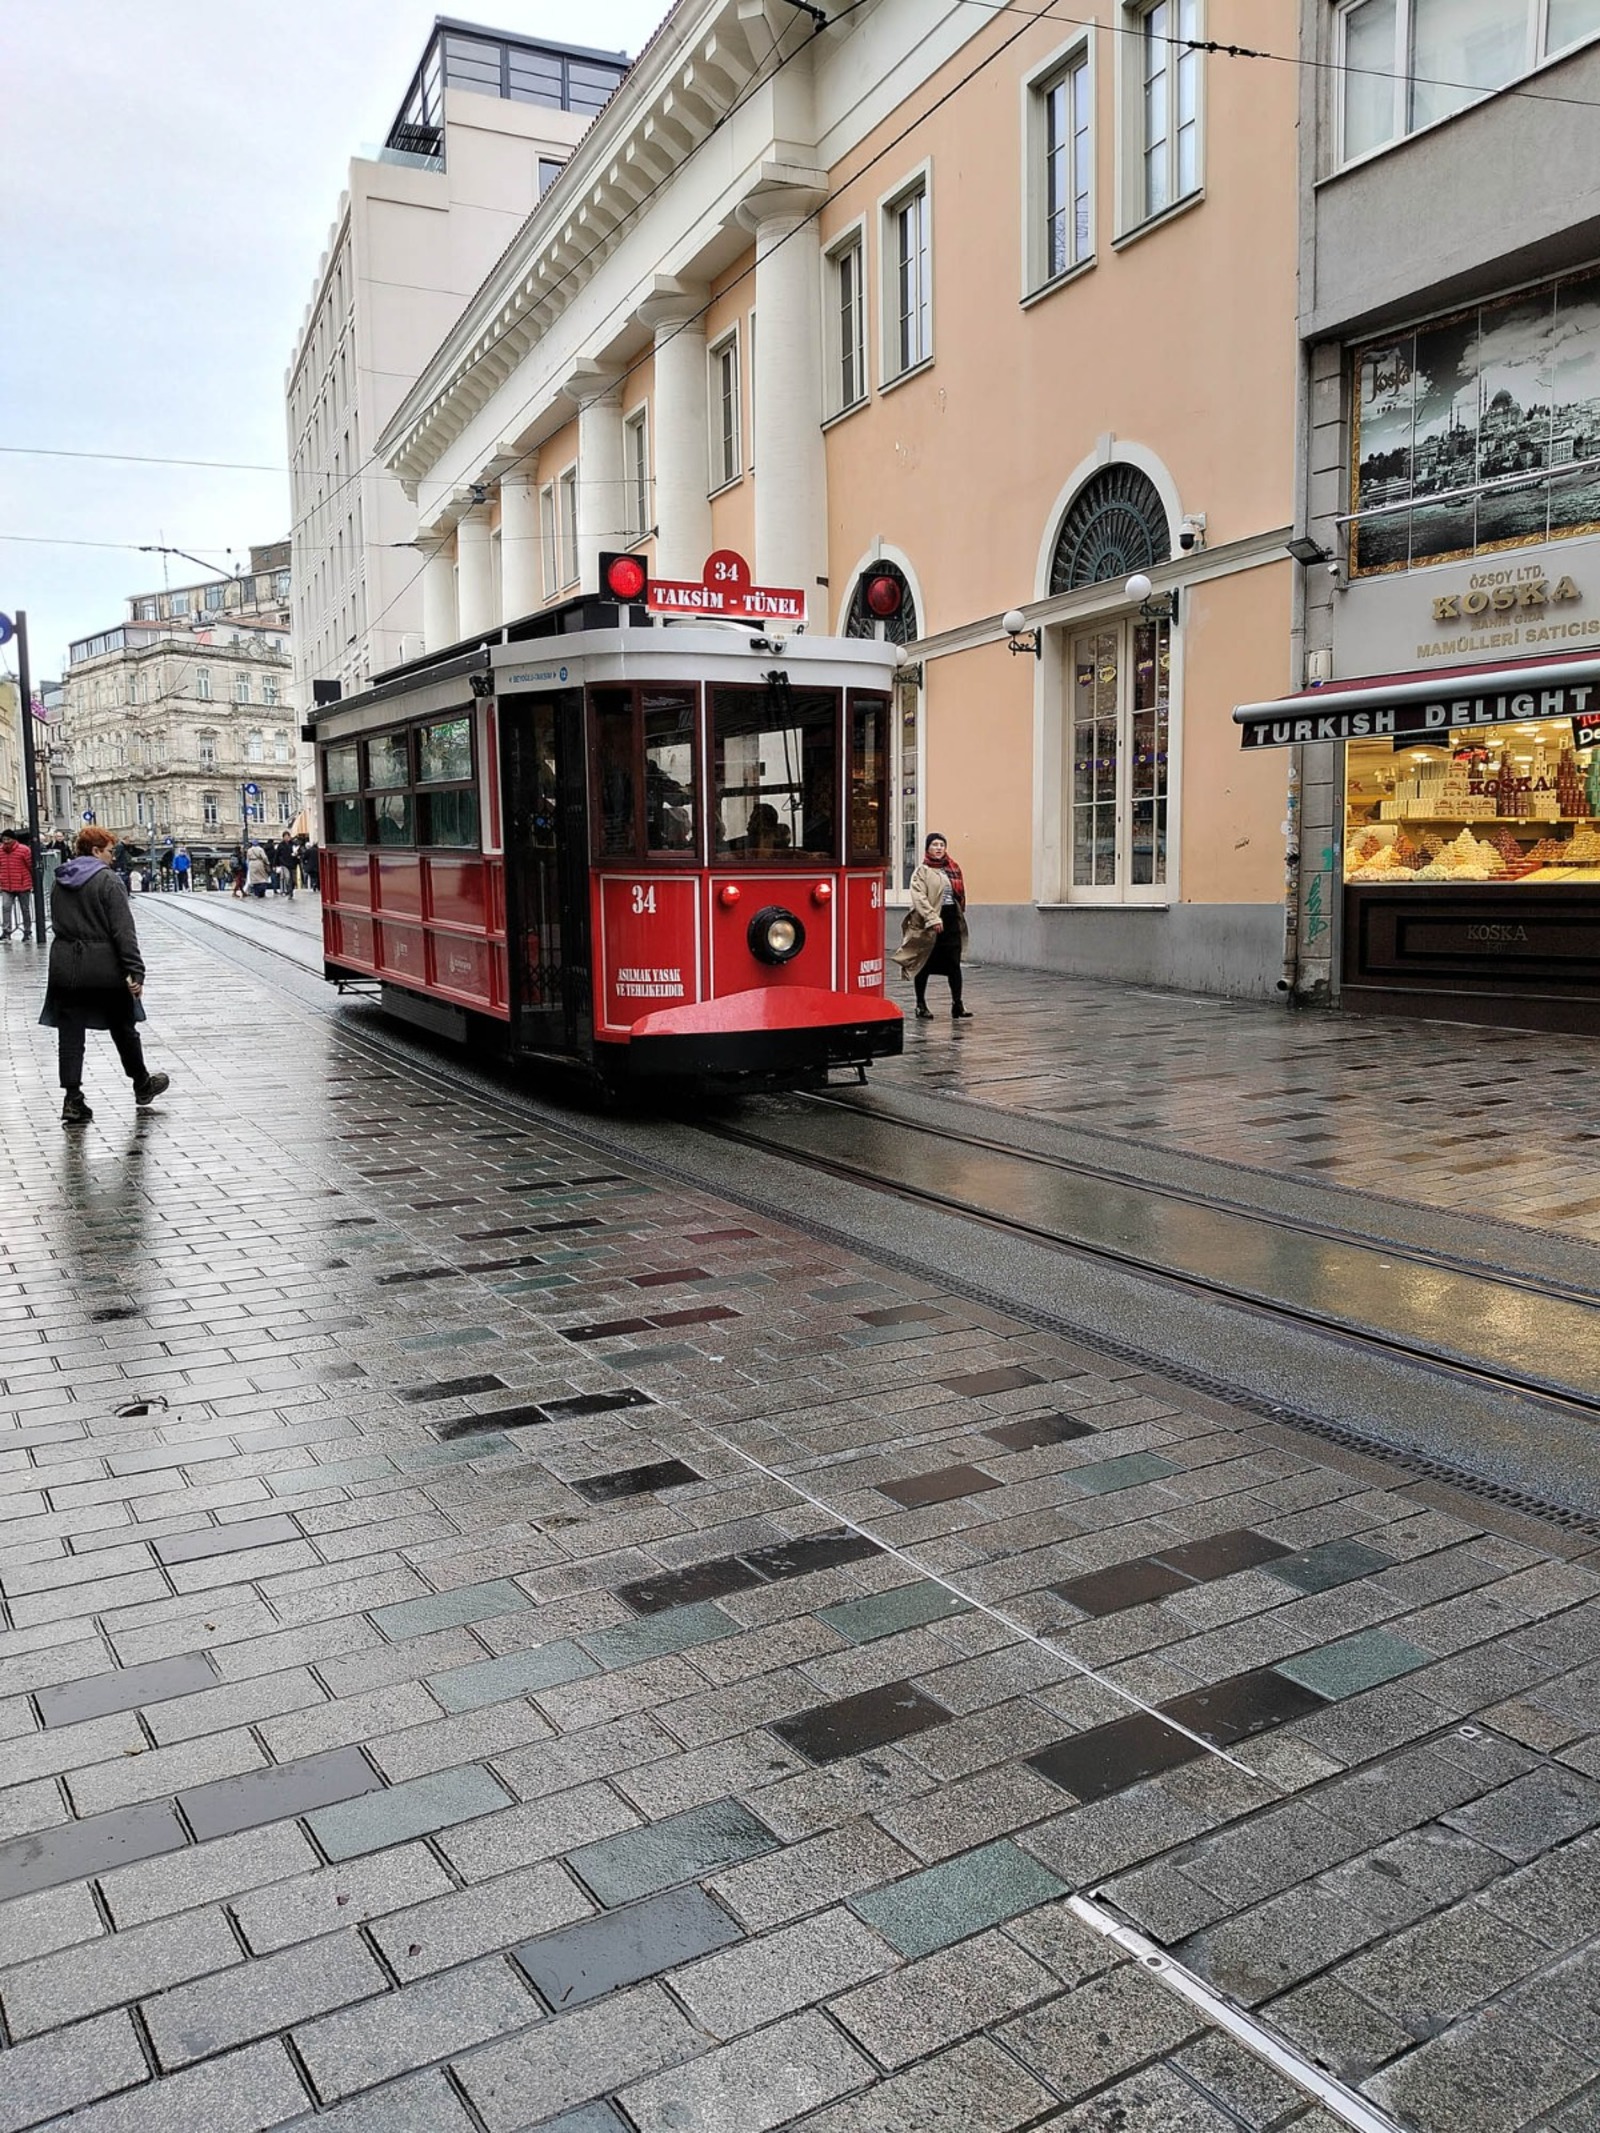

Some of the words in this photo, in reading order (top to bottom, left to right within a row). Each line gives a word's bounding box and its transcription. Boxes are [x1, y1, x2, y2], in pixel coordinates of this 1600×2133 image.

[714, 562, 739, 581] 34
[1469, 569, 1514, 590] ÖZSOY
[1516, 565, 1546, 581] LTD.
[653, 586, 724, 609] TAKSİM
[743, 591, 800, 615] TÜNEL
[1431, 575, 1583, 621] KOSKA
[1515, 611, 1545, 625] GIDA
[1416, 628, 1520, 659] MAMÜLLERİ
[1253, 709, 1396, 745] TURKISH
[1425, 687, 1593, 728] DELIGHT
[1468, 776, 1551, 796] KOSKA
[631, 884, 657, 914] 34
[871, 881, 882, 909] 34
[1467, 924, 1529, 941] KOSKA
[652, 968, 681, 982] YASAK
